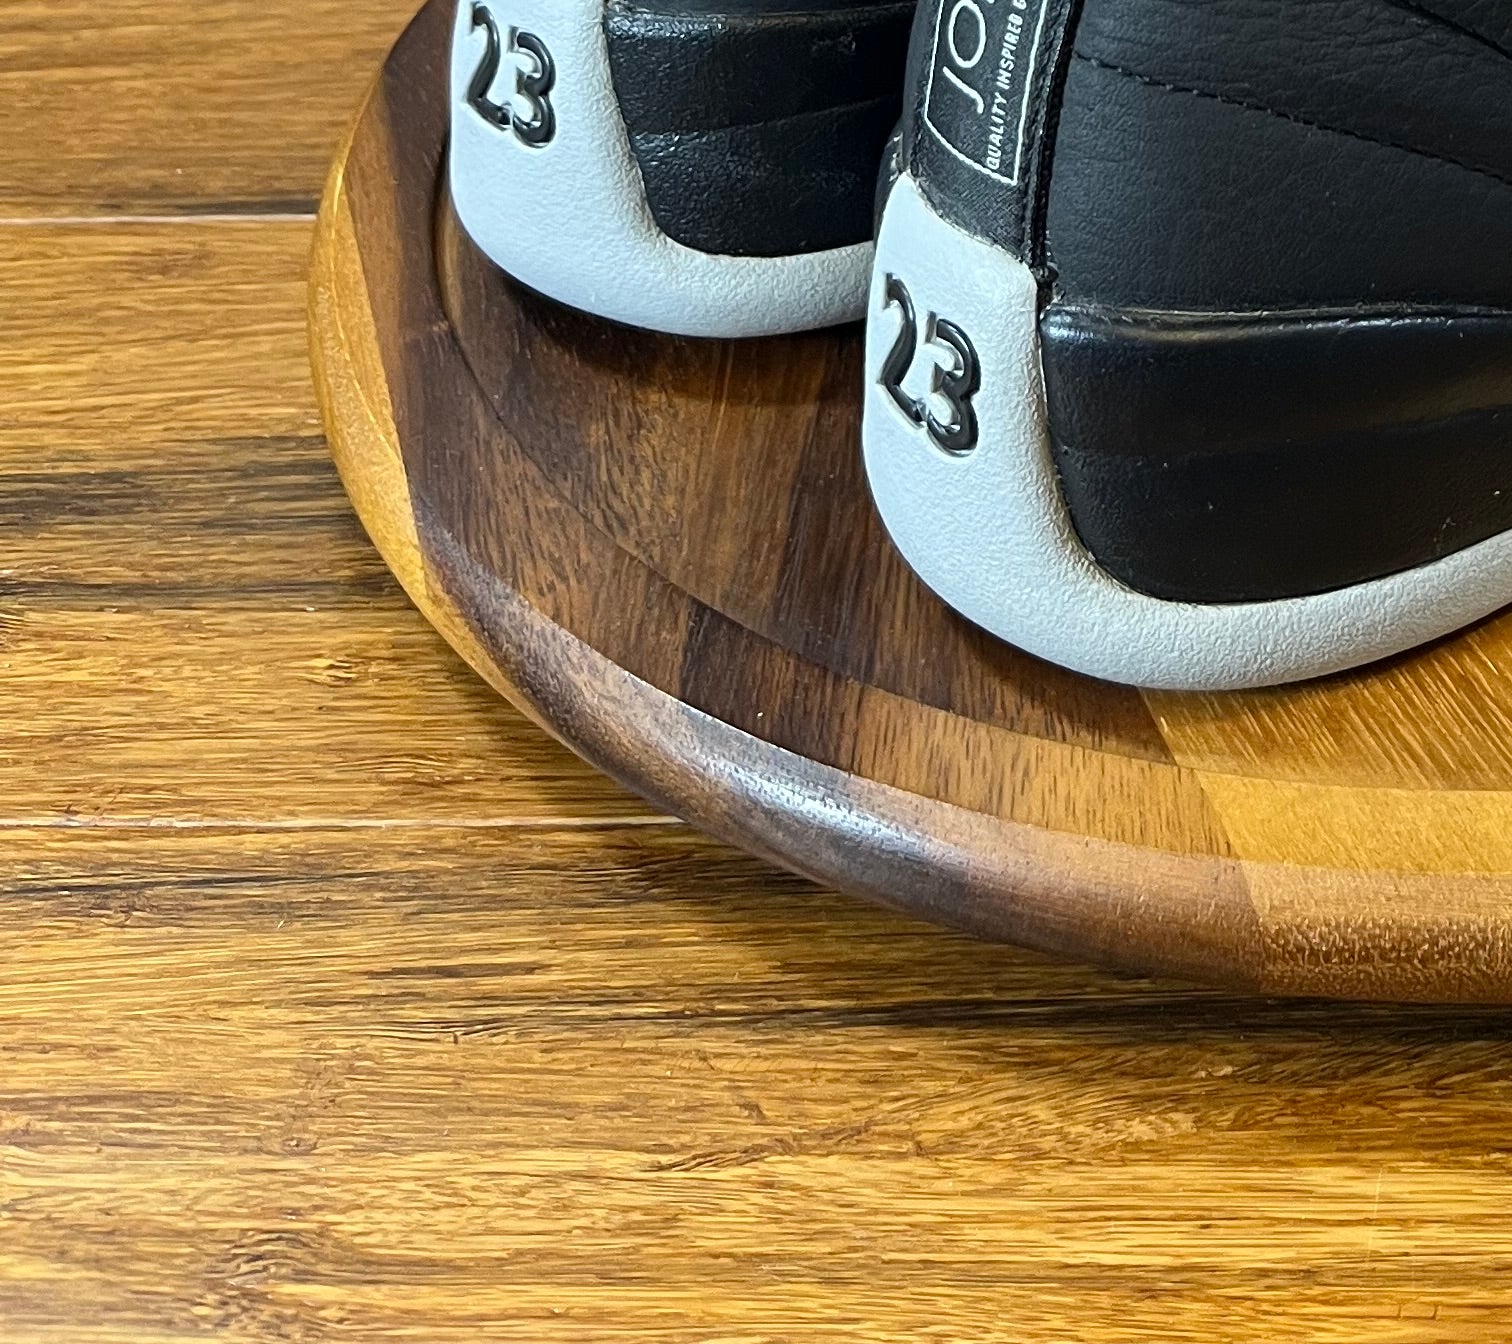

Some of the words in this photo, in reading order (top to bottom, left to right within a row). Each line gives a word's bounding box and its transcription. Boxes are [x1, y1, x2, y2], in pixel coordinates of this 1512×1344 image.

[465, 1, 557, 149] 23
[985, 92, 1007, 170] QUALITY
[996, 13, 1023, 90] INSPIRED
[876, 272, 981, 457] 23
